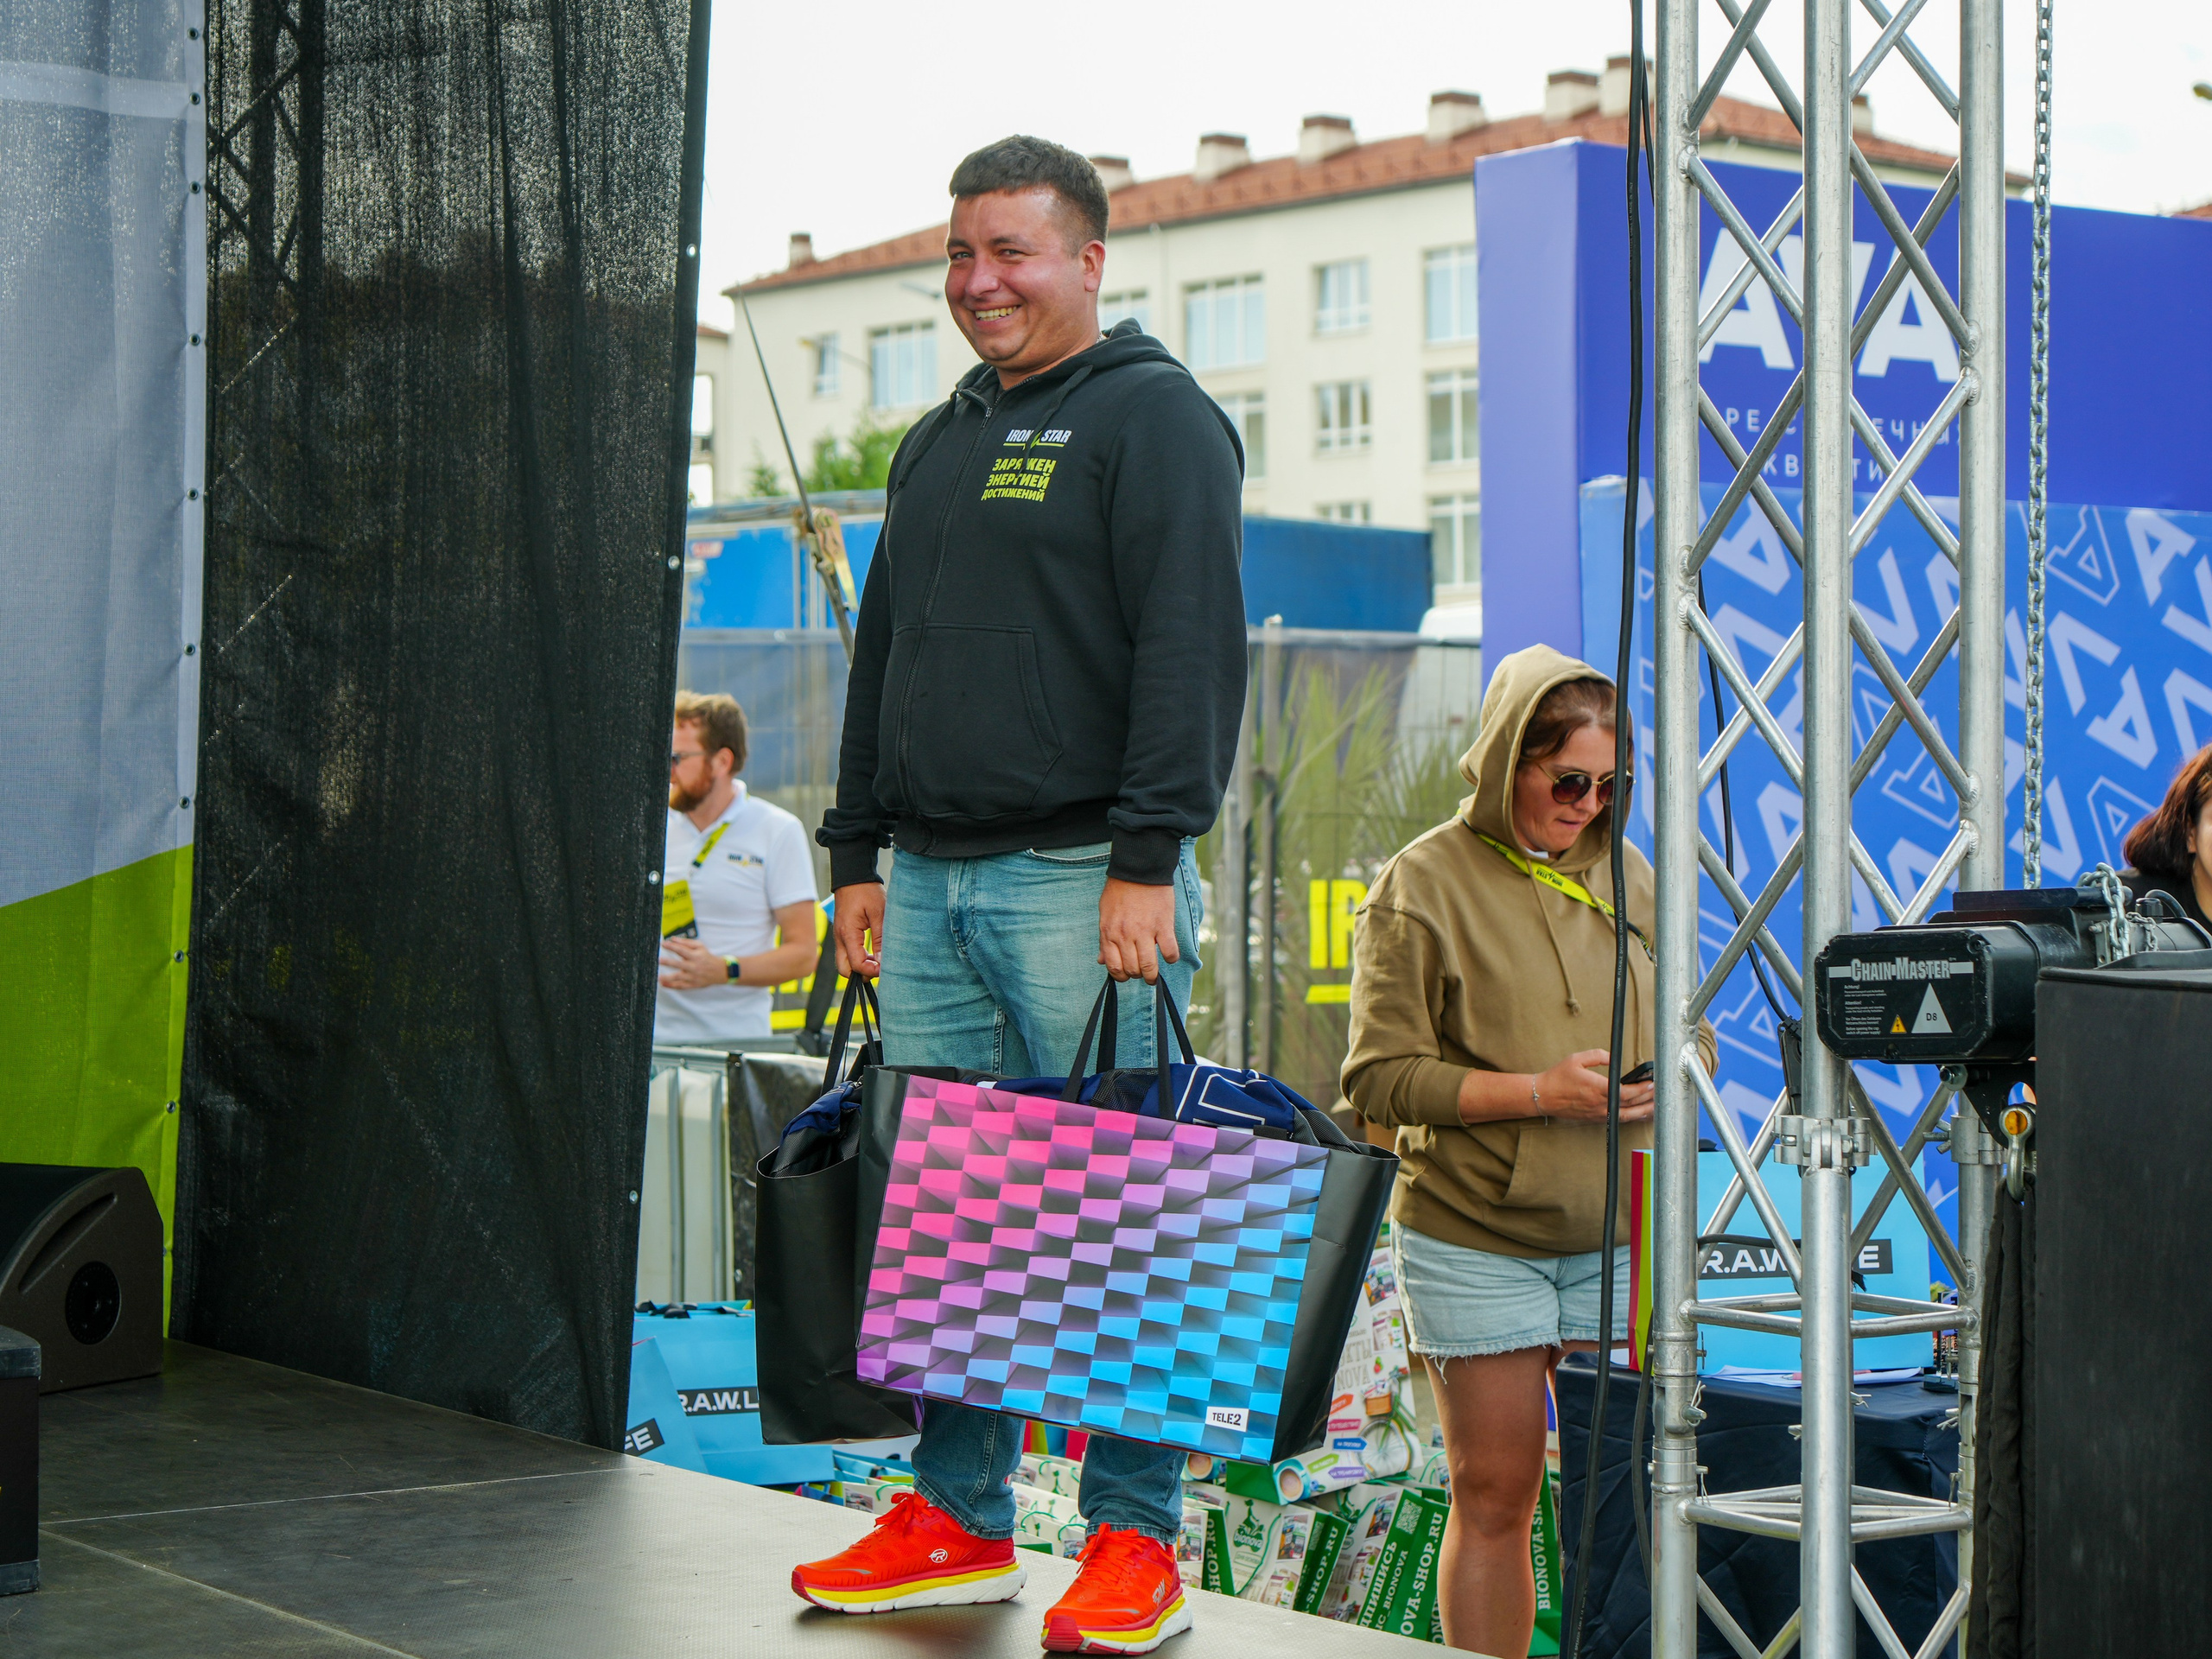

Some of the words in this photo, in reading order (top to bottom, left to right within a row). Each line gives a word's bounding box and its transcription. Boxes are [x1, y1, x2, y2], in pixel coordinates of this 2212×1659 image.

[1699, 227, 1960, 383] AA
[1006, 429, 1034, 442] IRON
[1040, 429, 1072, 443] STAR
[992, 457, 1057, 474] ЗАРЯЖЕН
[985, 472, 1051, 490] ЭНЕРГИЕЙ
[981, 488, 1046, 502] ДОСТИЖЕНИЙ
[1926, 1013, 1937, 1021] D8
[1212, 1412, 1242, 1427] TELE2
[1531, 1496, 1552, 1611] BIONOVA-SH
